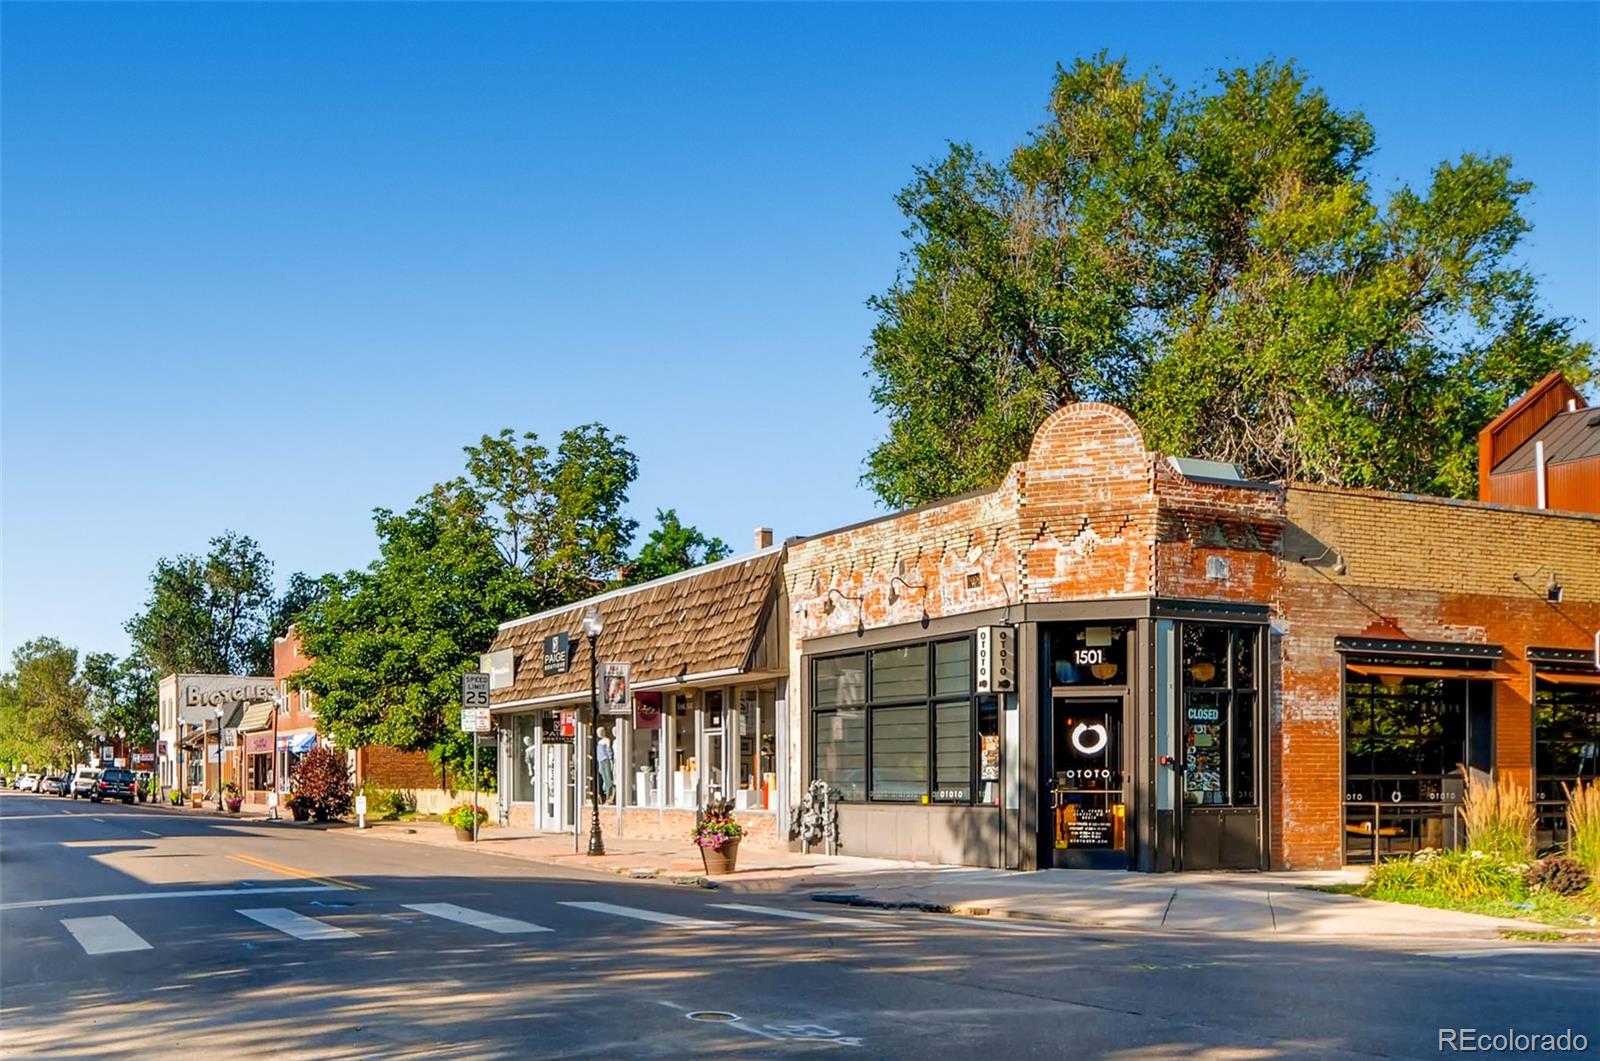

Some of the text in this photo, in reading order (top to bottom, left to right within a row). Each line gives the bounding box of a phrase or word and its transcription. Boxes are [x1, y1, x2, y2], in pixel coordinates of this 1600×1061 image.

[544, 651, 566, 663] PAIGE
[1074, 649, 1102, 665] 1501
[466, 691, 487, 704] 25
[1188, 708, 1219, 720] CLOSED
[1066, 769, 1110, 779] OTOTO
[940, 790, 963, 798] OTOTO
[1430, 792, 1456, 800] OTOTO
